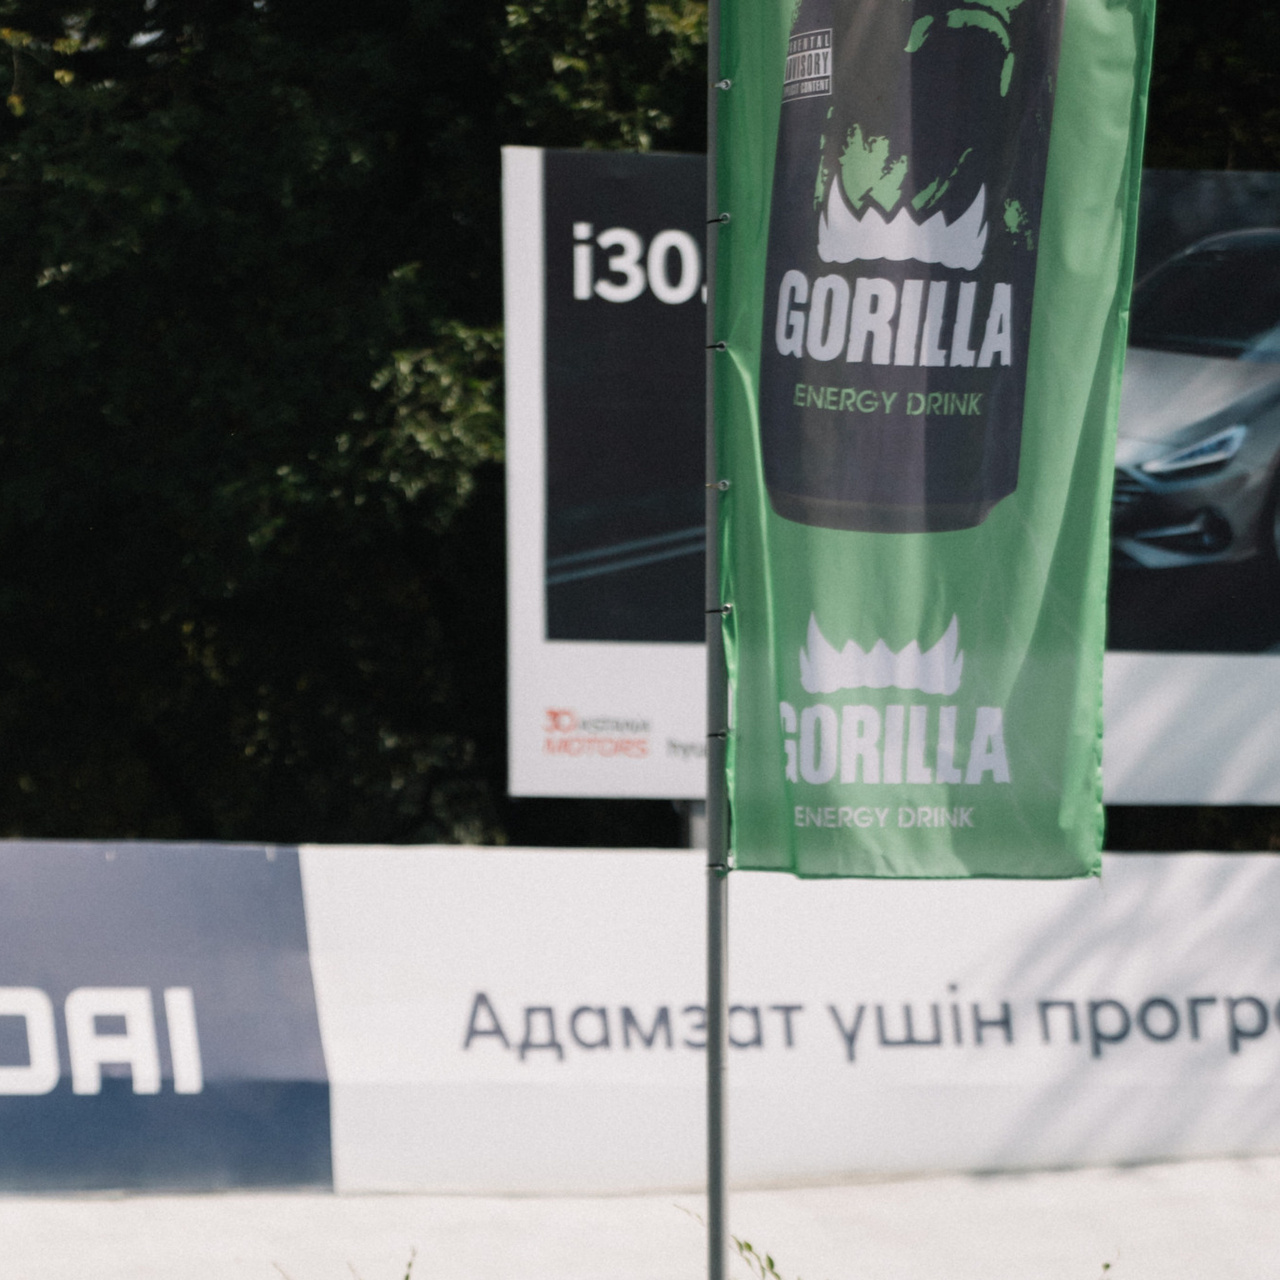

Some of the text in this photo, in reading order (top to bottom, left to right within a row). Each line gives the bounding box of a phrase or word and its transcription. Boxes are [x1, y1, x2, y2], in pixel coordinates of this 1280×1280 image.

[573, 221, 707, 305] i30
[775, 269, 1013, 368] GORILLA
[793, 383, 983, 416] ENERGY DRINK
[542, 735, 650, 760] MOTORS
[779, 701, 1011, 785] GORILLA
[794, 806, 975, 828] ENERGY DRINK
[463, 983, 1280, 1063] Адамзат үшін прогр
